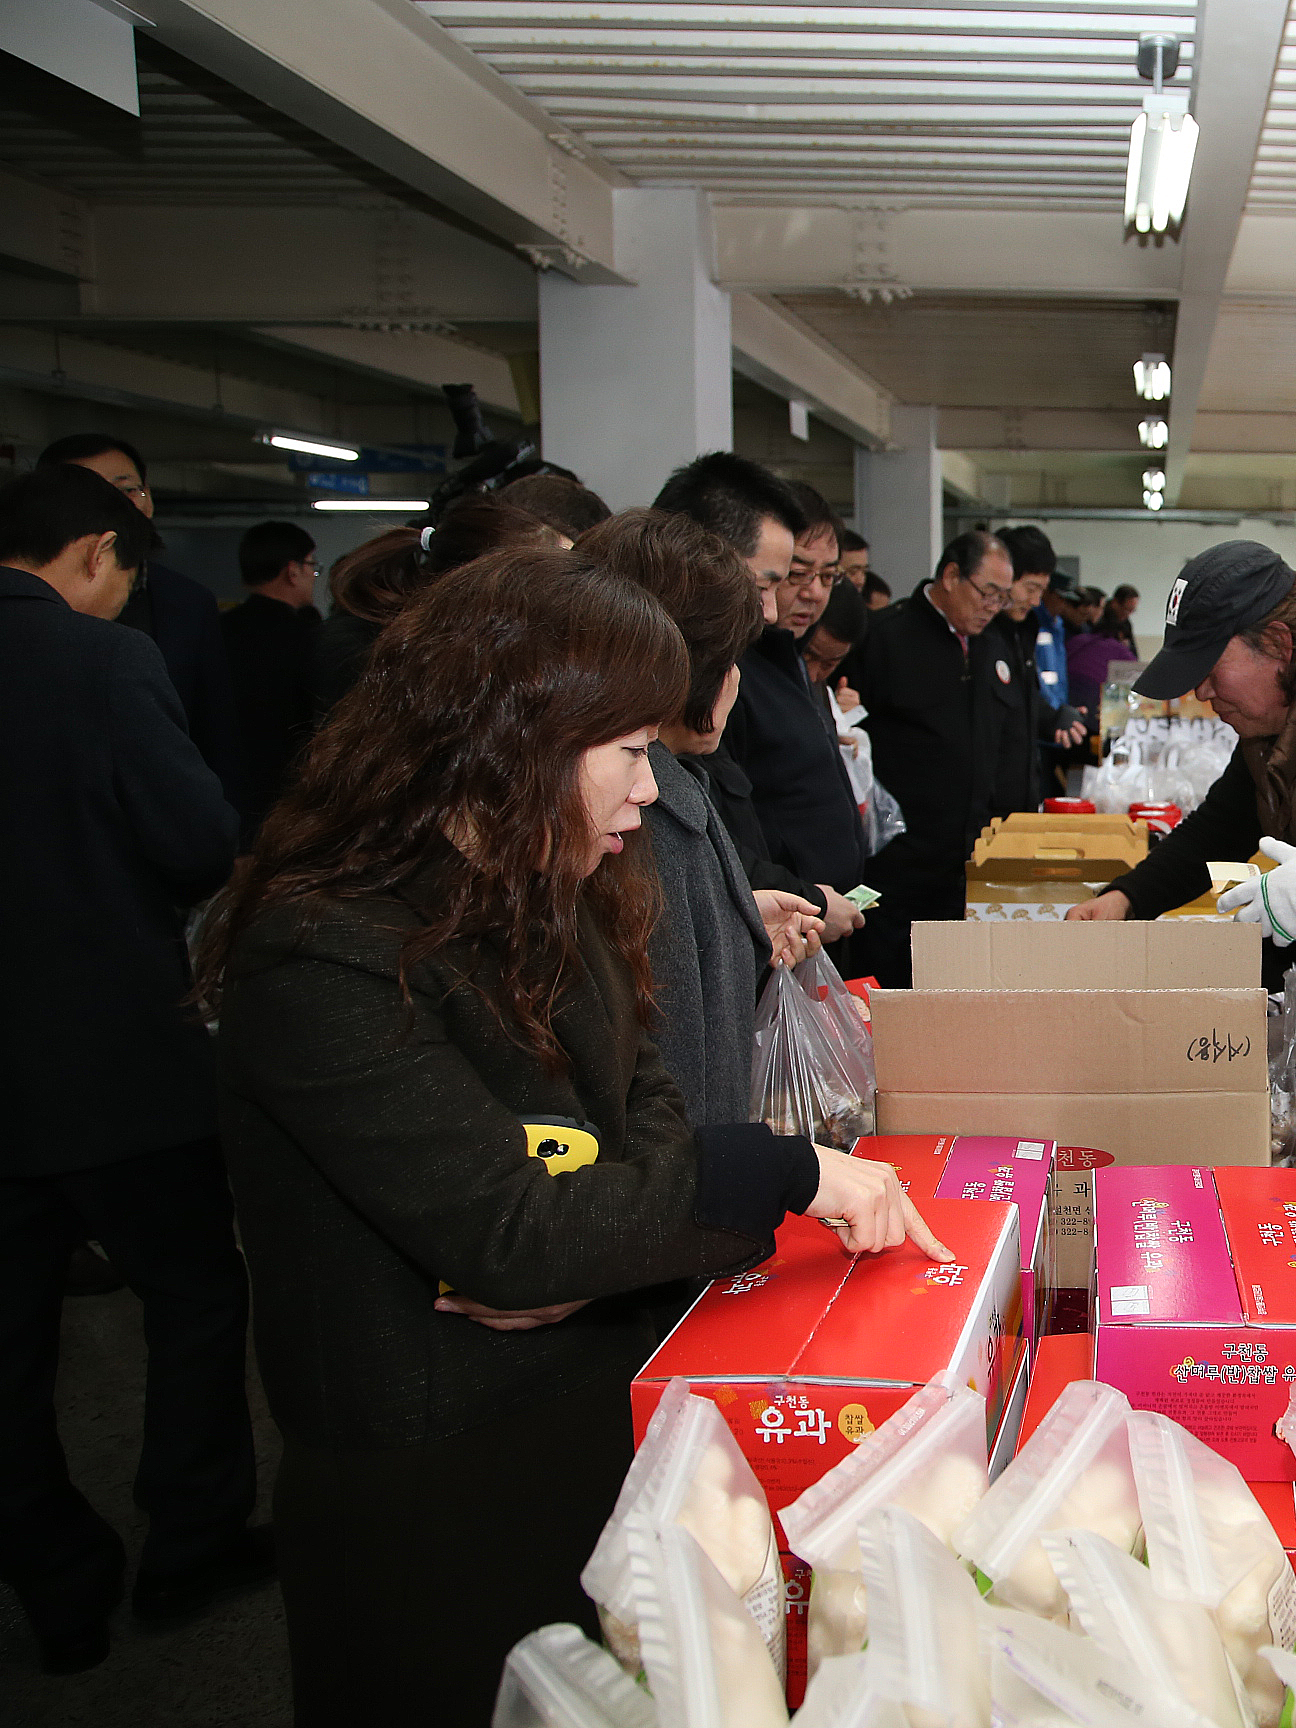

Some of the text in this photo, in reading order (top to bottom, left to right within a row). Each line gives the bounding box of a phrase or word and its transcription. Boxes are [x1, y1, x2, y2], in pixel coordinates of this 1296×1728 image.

[1060, 1217, 1090, 1226] 322-8
[1167, 1219, 1195, 1244] 구천동
[1131, 1199, 1164, 1270] 산머루(반)찹쌀 유과
[1257, 1222, 1285, 1247] 구천동
[721, 1272, 762, 1295] 유과
[932, 1263, 970, 1287] 유과
[1221, 1343, 1268, 1363] 구천동
[1173, 1364, 1279, 1385] 산머루(반)찹쌀
[773, 1394, 810, 1410] 구천동
[754, 1405, 833, 1444] 유과
[844, 1413, 865, 1426] 찹쌀
[844, 1425, 865, 1436] 유과
